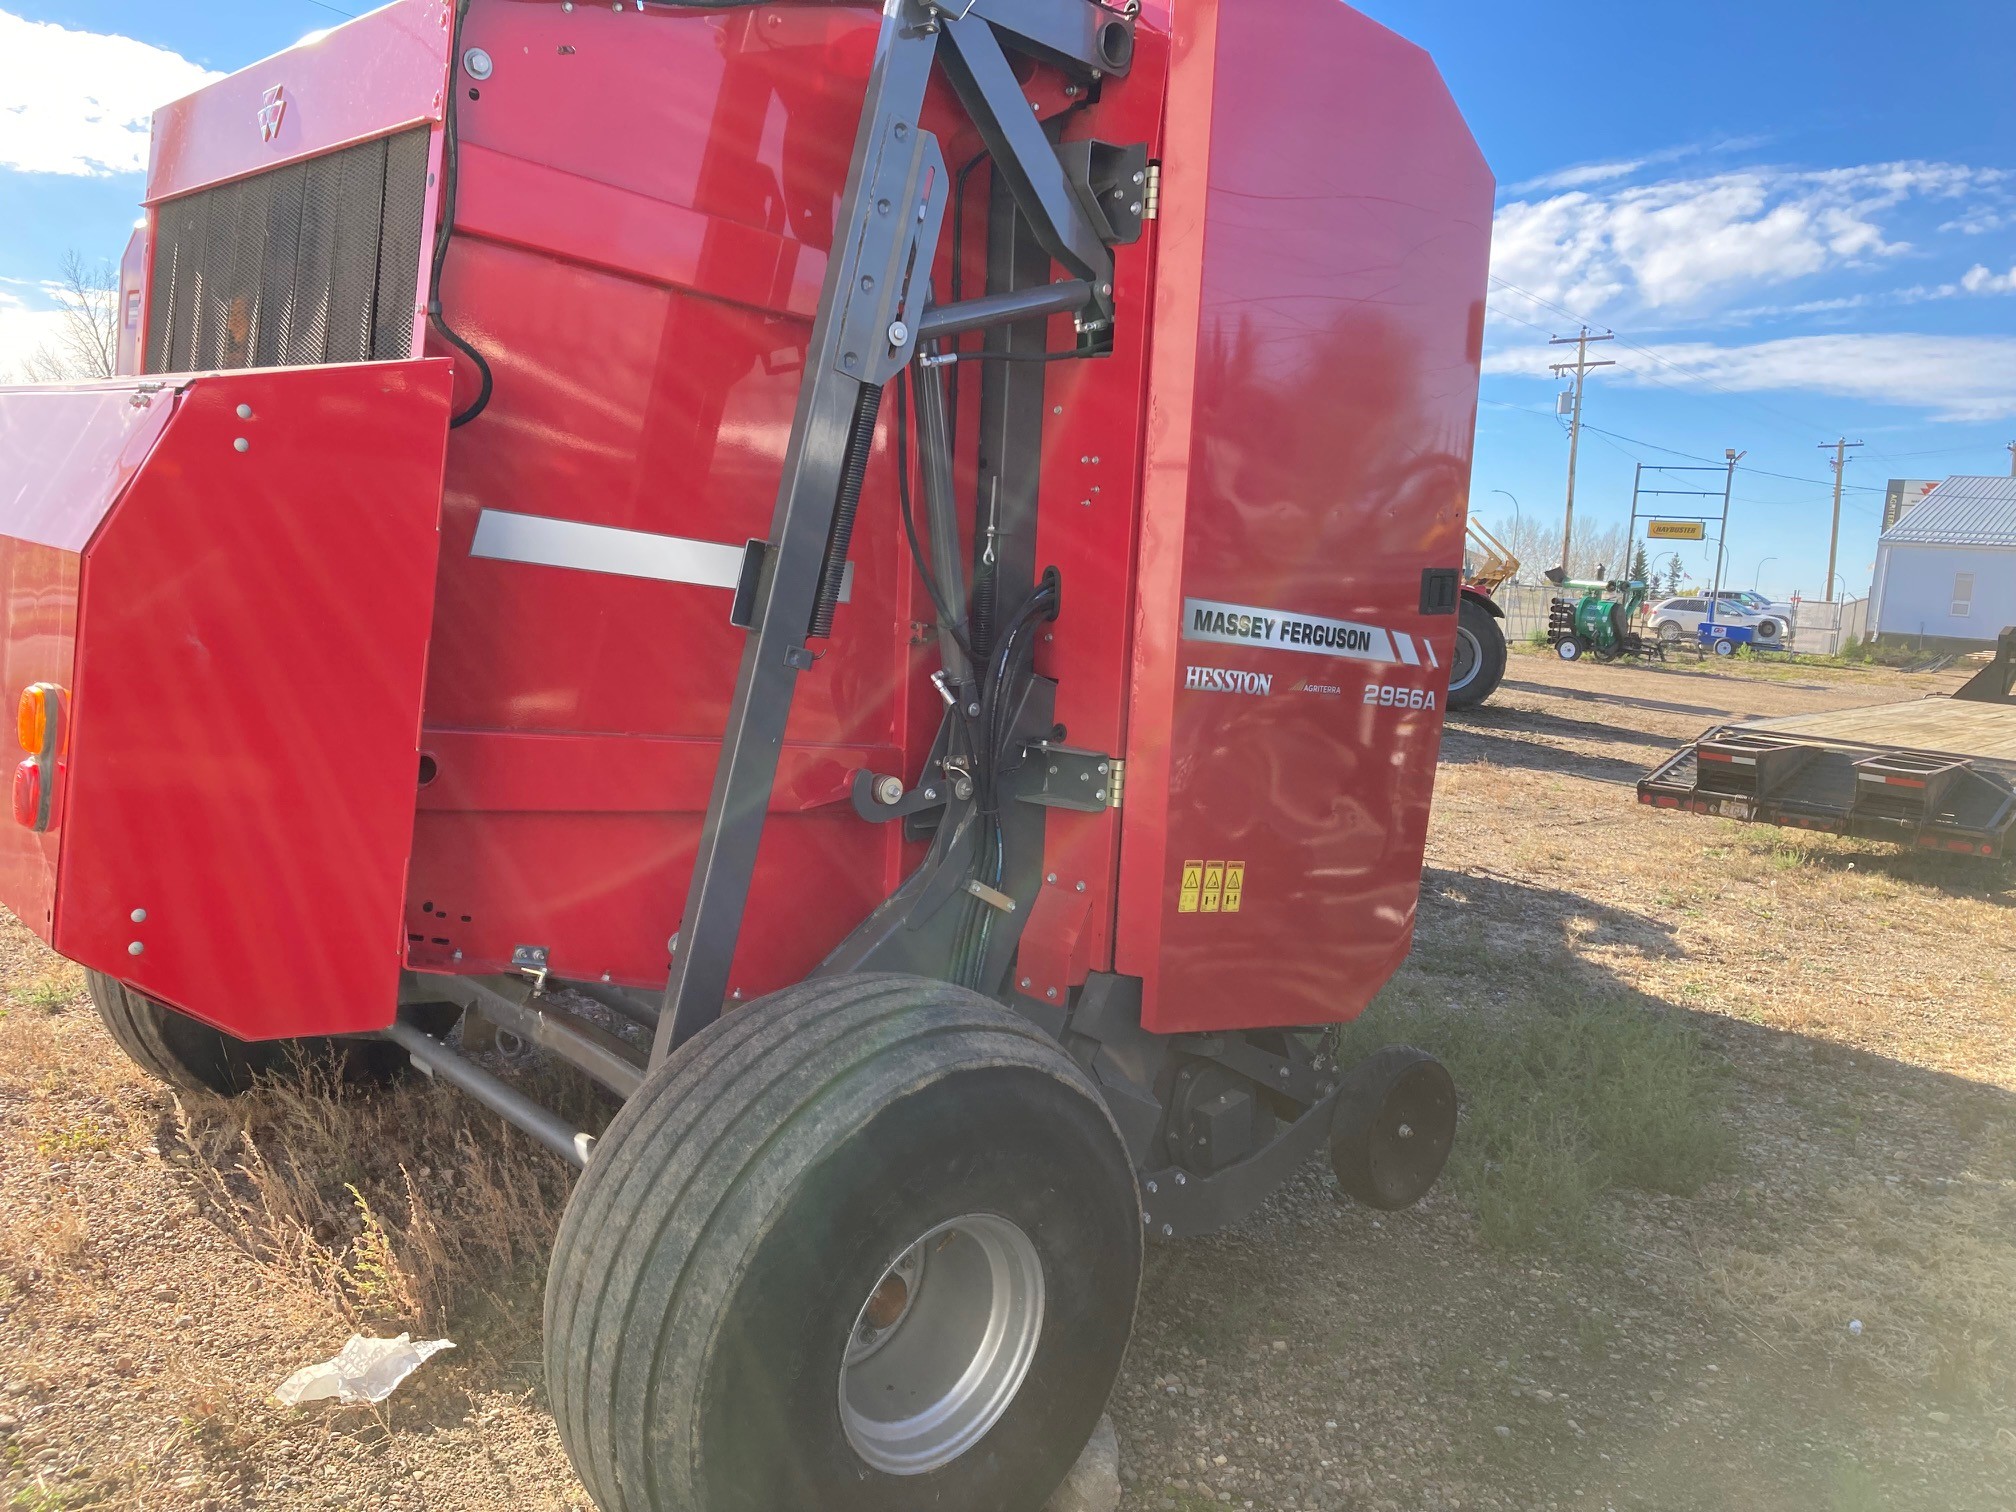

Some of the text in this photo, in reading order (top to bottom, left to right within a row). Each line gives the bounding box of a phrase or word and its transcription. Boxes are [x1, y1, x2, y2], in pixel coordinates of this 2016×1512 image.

[1887, 494, 1898, 530] AGRITERR
[1656, 526, 1696, 534] HAYBUSTER
[1193, 609, 1371, 652] MASSEY FERGUSON
[1184, 665, 1273, 696] HESSTON
[1303, 684, 1341, 695] AGRITERRA
[1363, 684, 1436, 711] 2956A
